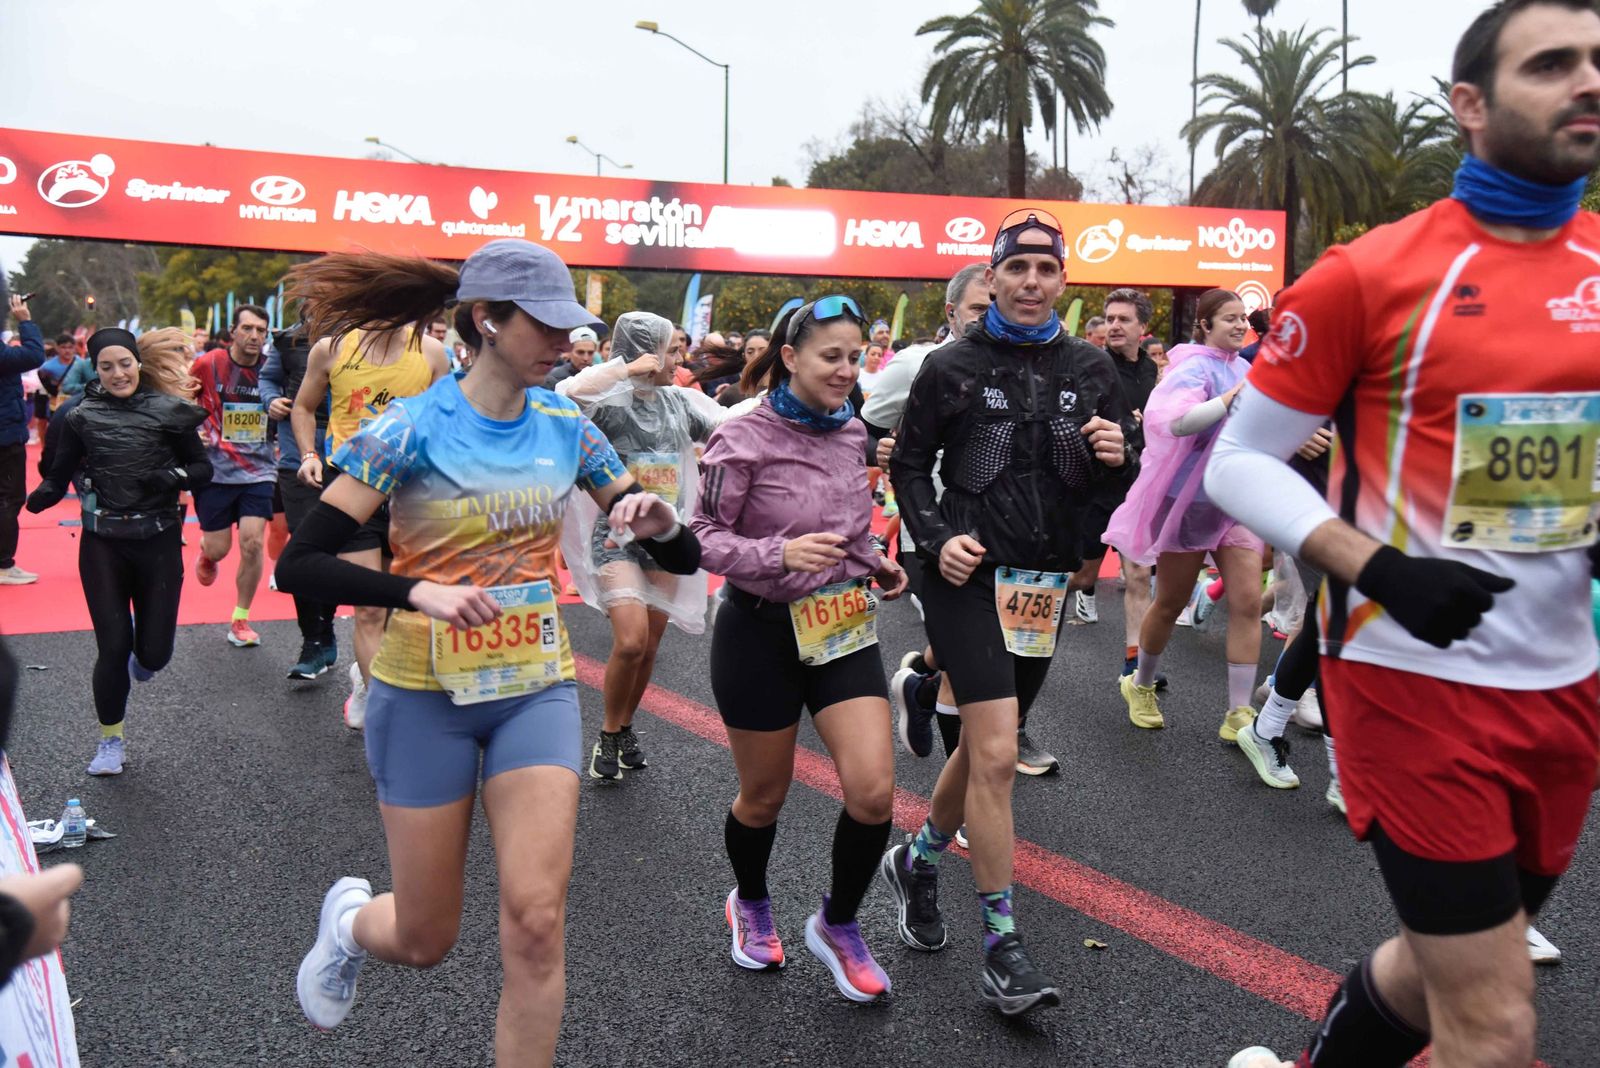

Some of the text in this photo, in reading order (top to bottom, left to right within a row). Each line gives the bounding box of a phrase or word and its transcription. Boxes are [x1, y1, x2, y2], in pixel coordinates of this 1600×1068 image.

[125, 178, 230, 203] Sprinter
[239, 204, 317, 223] HYUNDAI
[333, 190, 436, 226] HOKA
[843, 218, 925, 249] HOKA
[227, 413, 260, 425] 18200
[986, 398, 1009, 410] MAX
[1486, 434, 1583, 482] 8691
[468, 484, 553, 514] MEDIO
[800, 589, 867, 629] 16156
[1006, 590, 1053, 619] 4758
[445, 612, 541, 654] 16335
